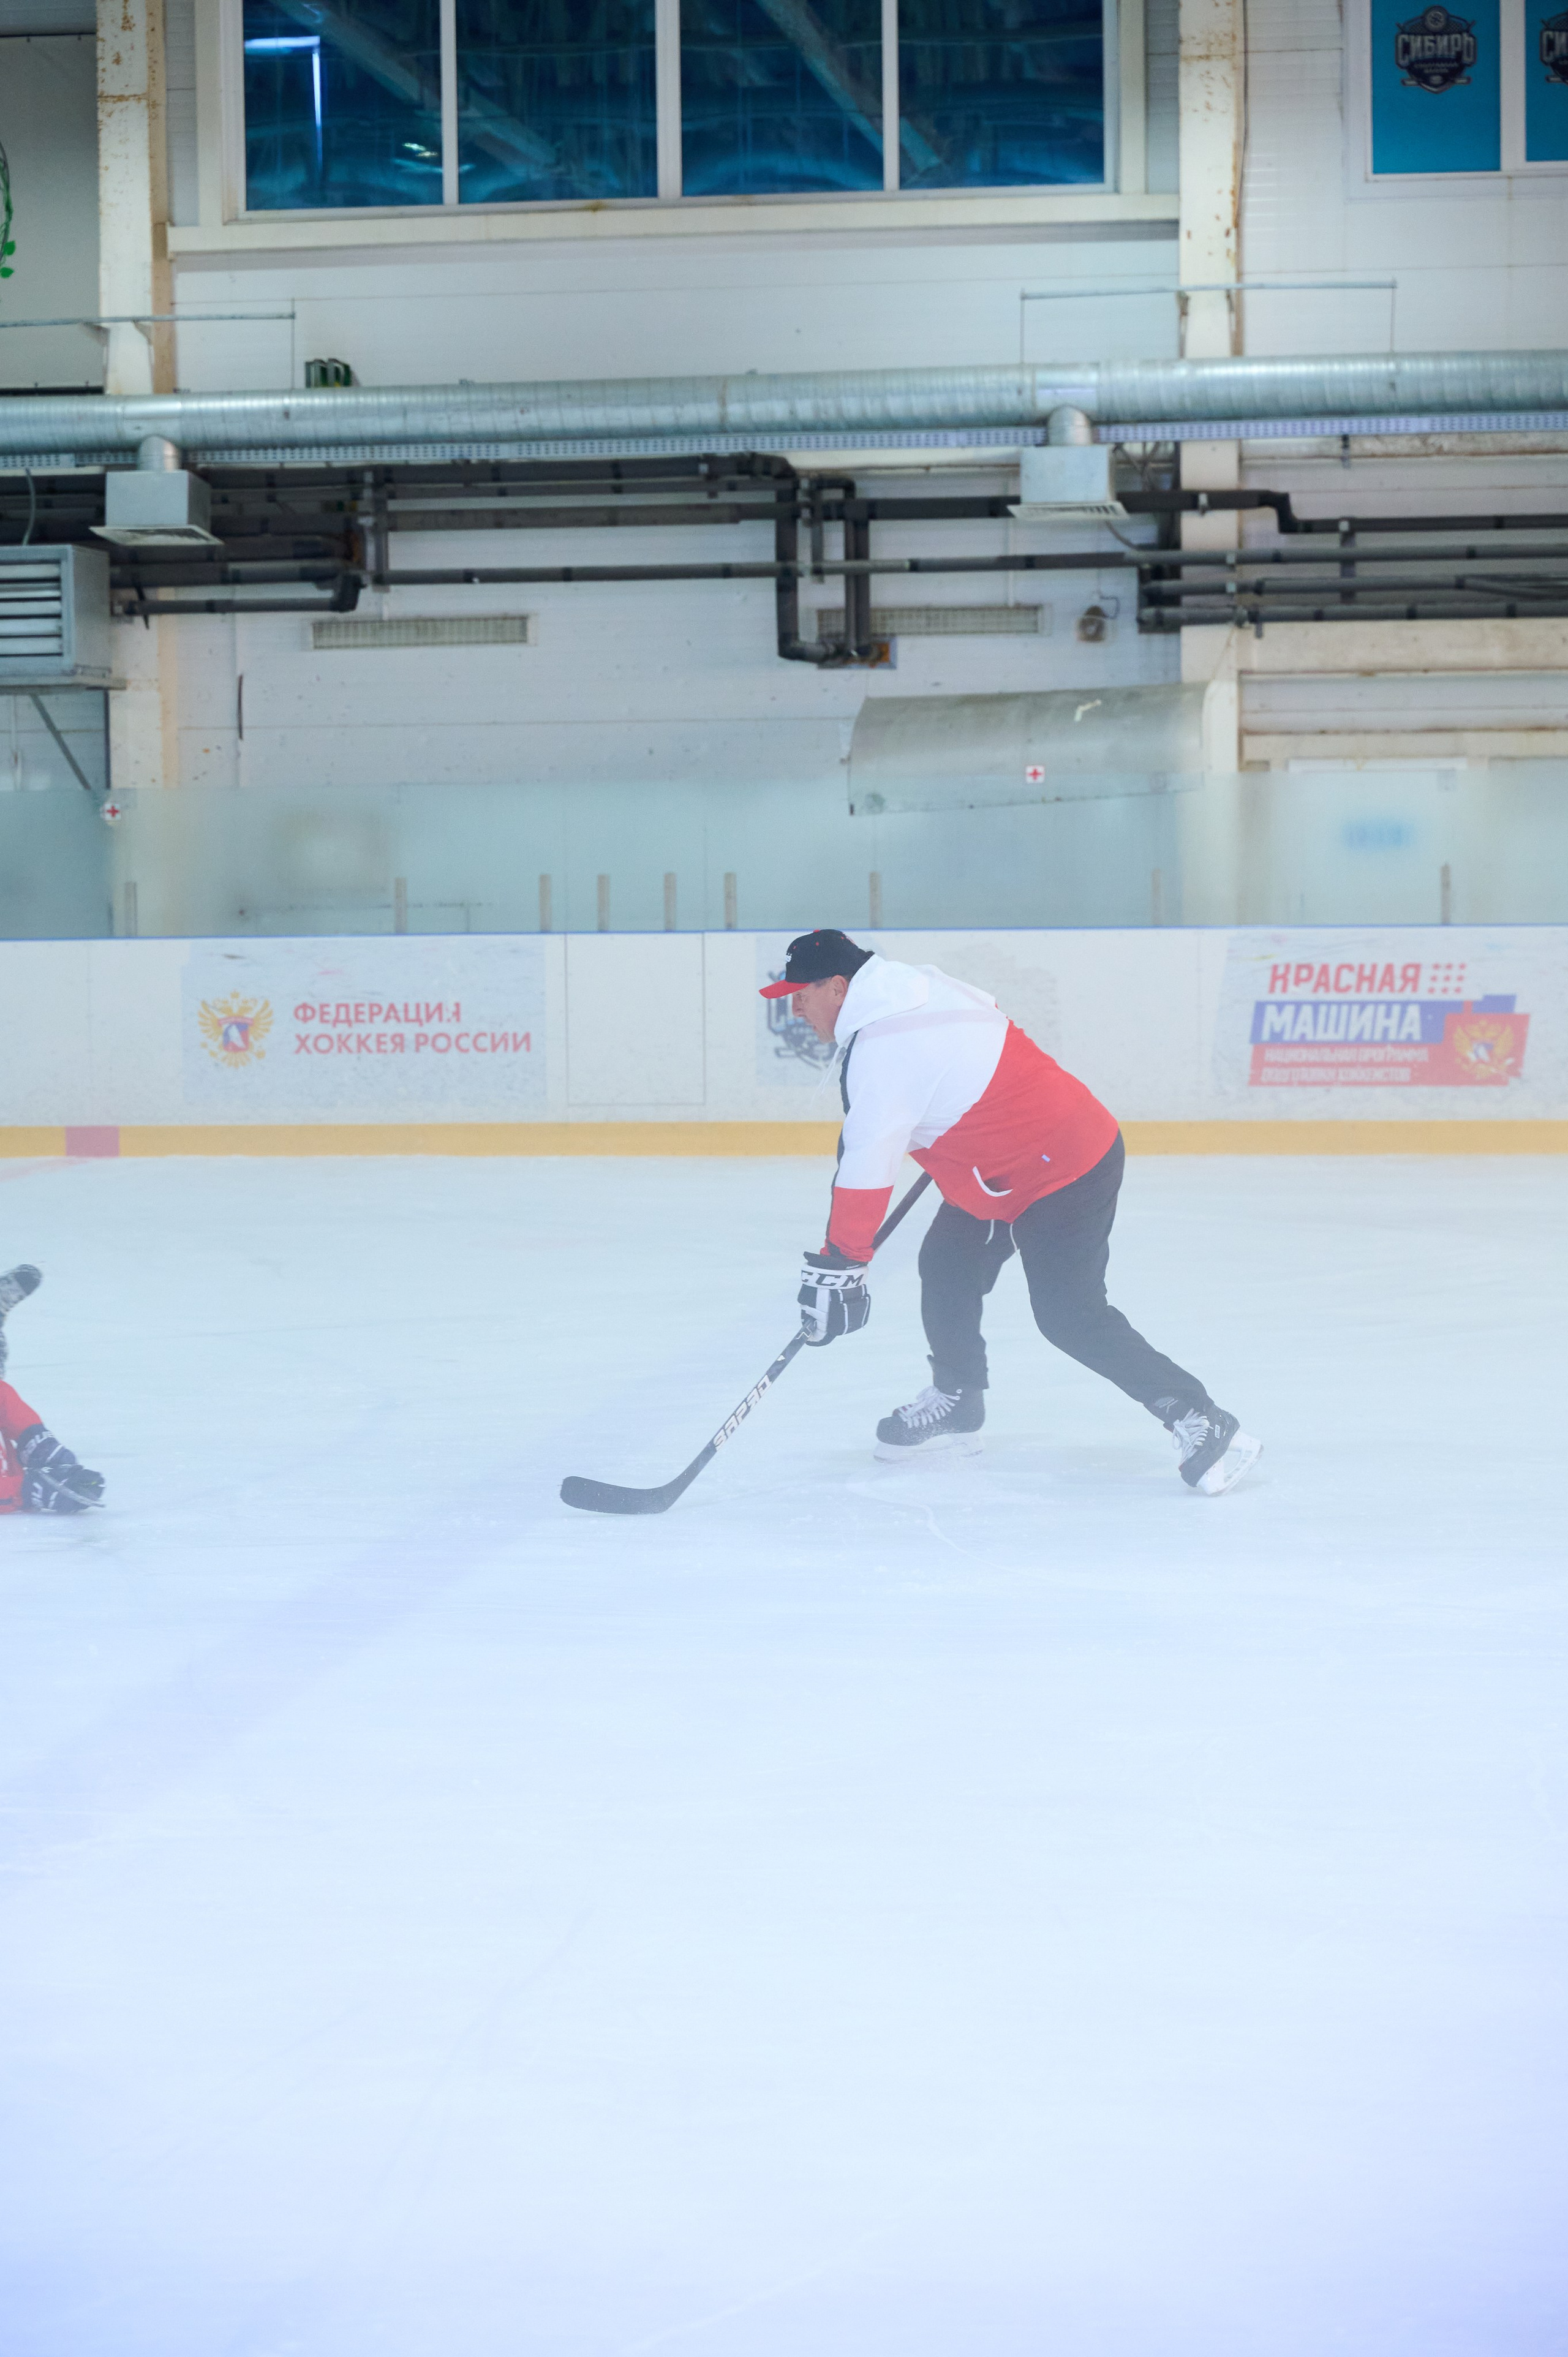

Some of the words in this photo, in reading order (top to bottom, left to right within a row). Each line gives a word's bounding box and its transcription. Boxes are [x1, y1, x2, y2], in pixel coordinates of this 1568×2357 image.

[1398, 32, 1474, 65] СИБИРЬ
[1268, 963, 1422, 994] КРАСНАЯ
[293, 1001, 461, 1027] ФЕДЕРАЦИЯ
[1261, 1003, 1422, 1041] МАШИНА
[294, 1032, 405, 1054] ХОККЕЯ
[415, 1031, 532, 1054] РОССИИ
